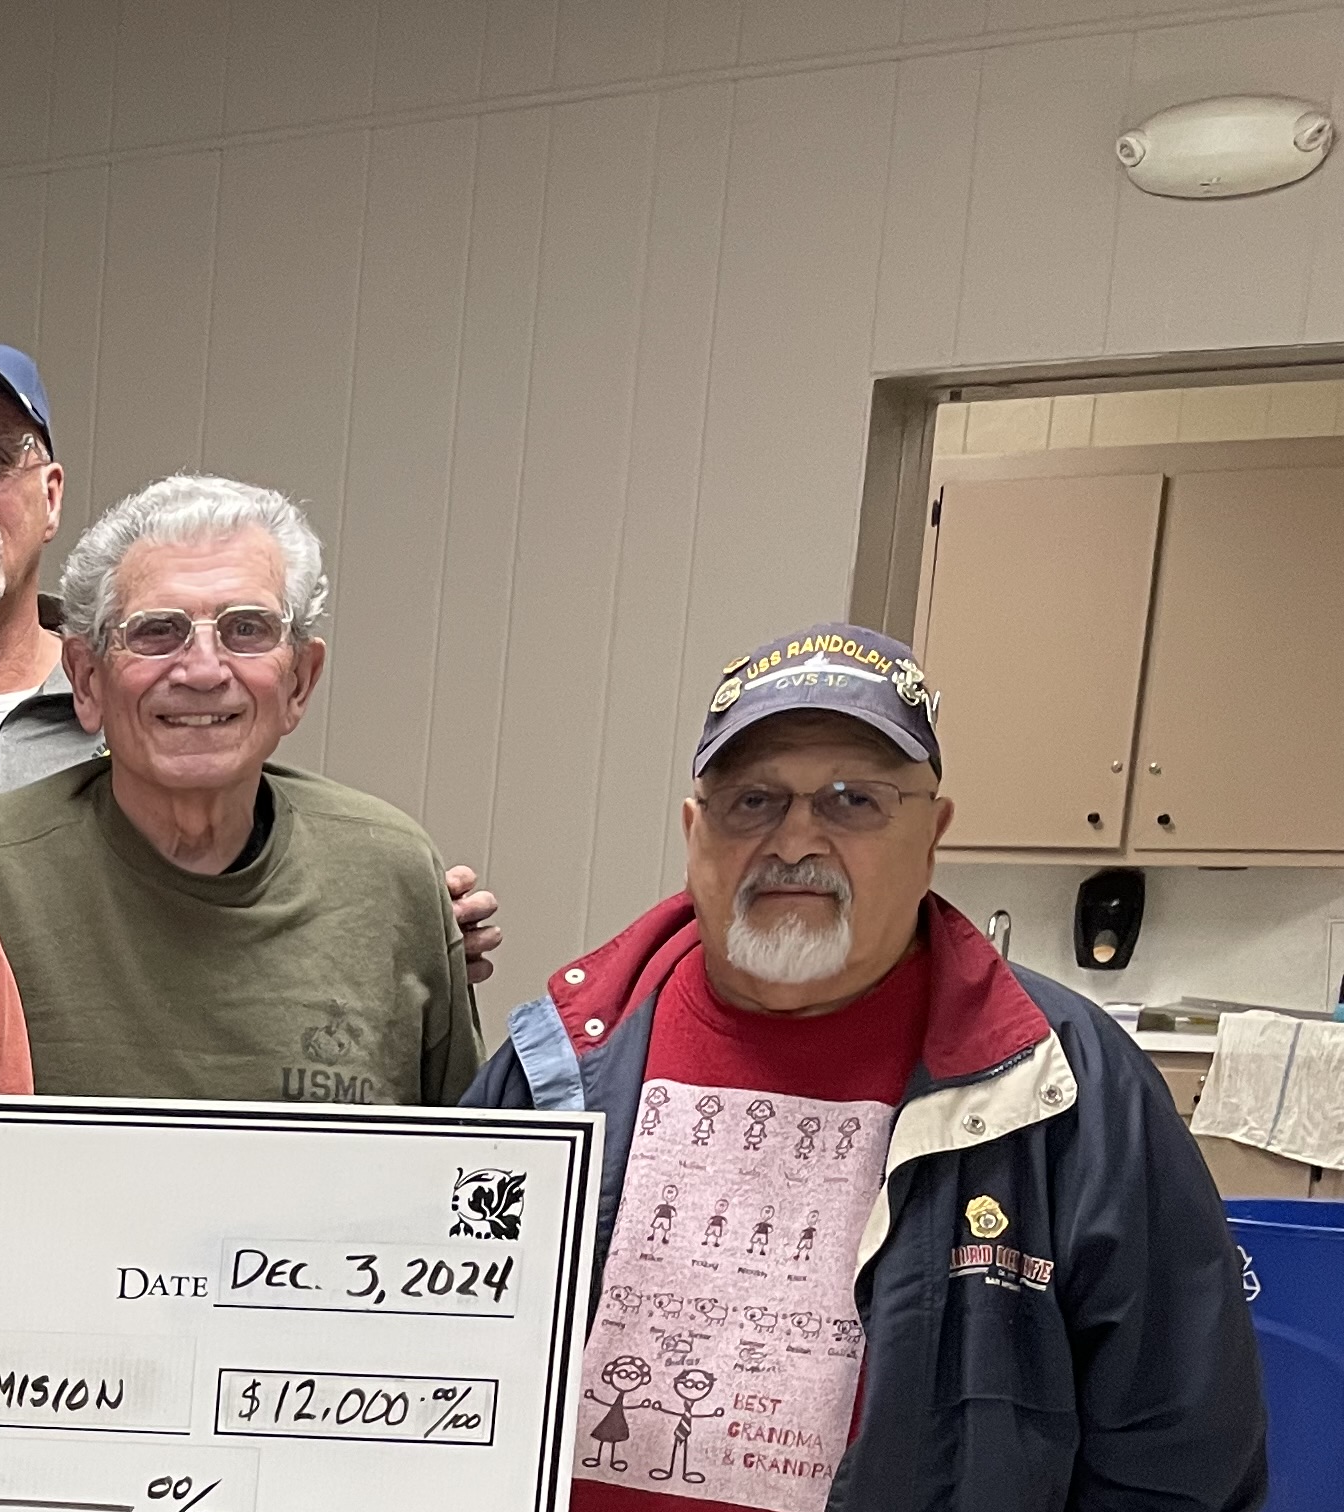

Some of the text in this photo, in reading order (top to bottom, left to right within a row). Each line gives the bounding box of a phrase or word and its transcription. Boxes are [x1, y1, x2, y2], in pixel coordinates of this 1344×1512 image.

[746, 634, 893, 680] USS RANDOLPH
[281, 1067, 374, 1102] USMC
[116, 1267, 208, 1299] DATE
[232, 1249, 322, 1292] DEC.
[401, 1256, 514, 1303] 2024
[733, 1392, 782, 1416] BEST
[727, 1420, 824, 1452] GRANDMA
[743, 1452, 834, 1479] GRANDPA
